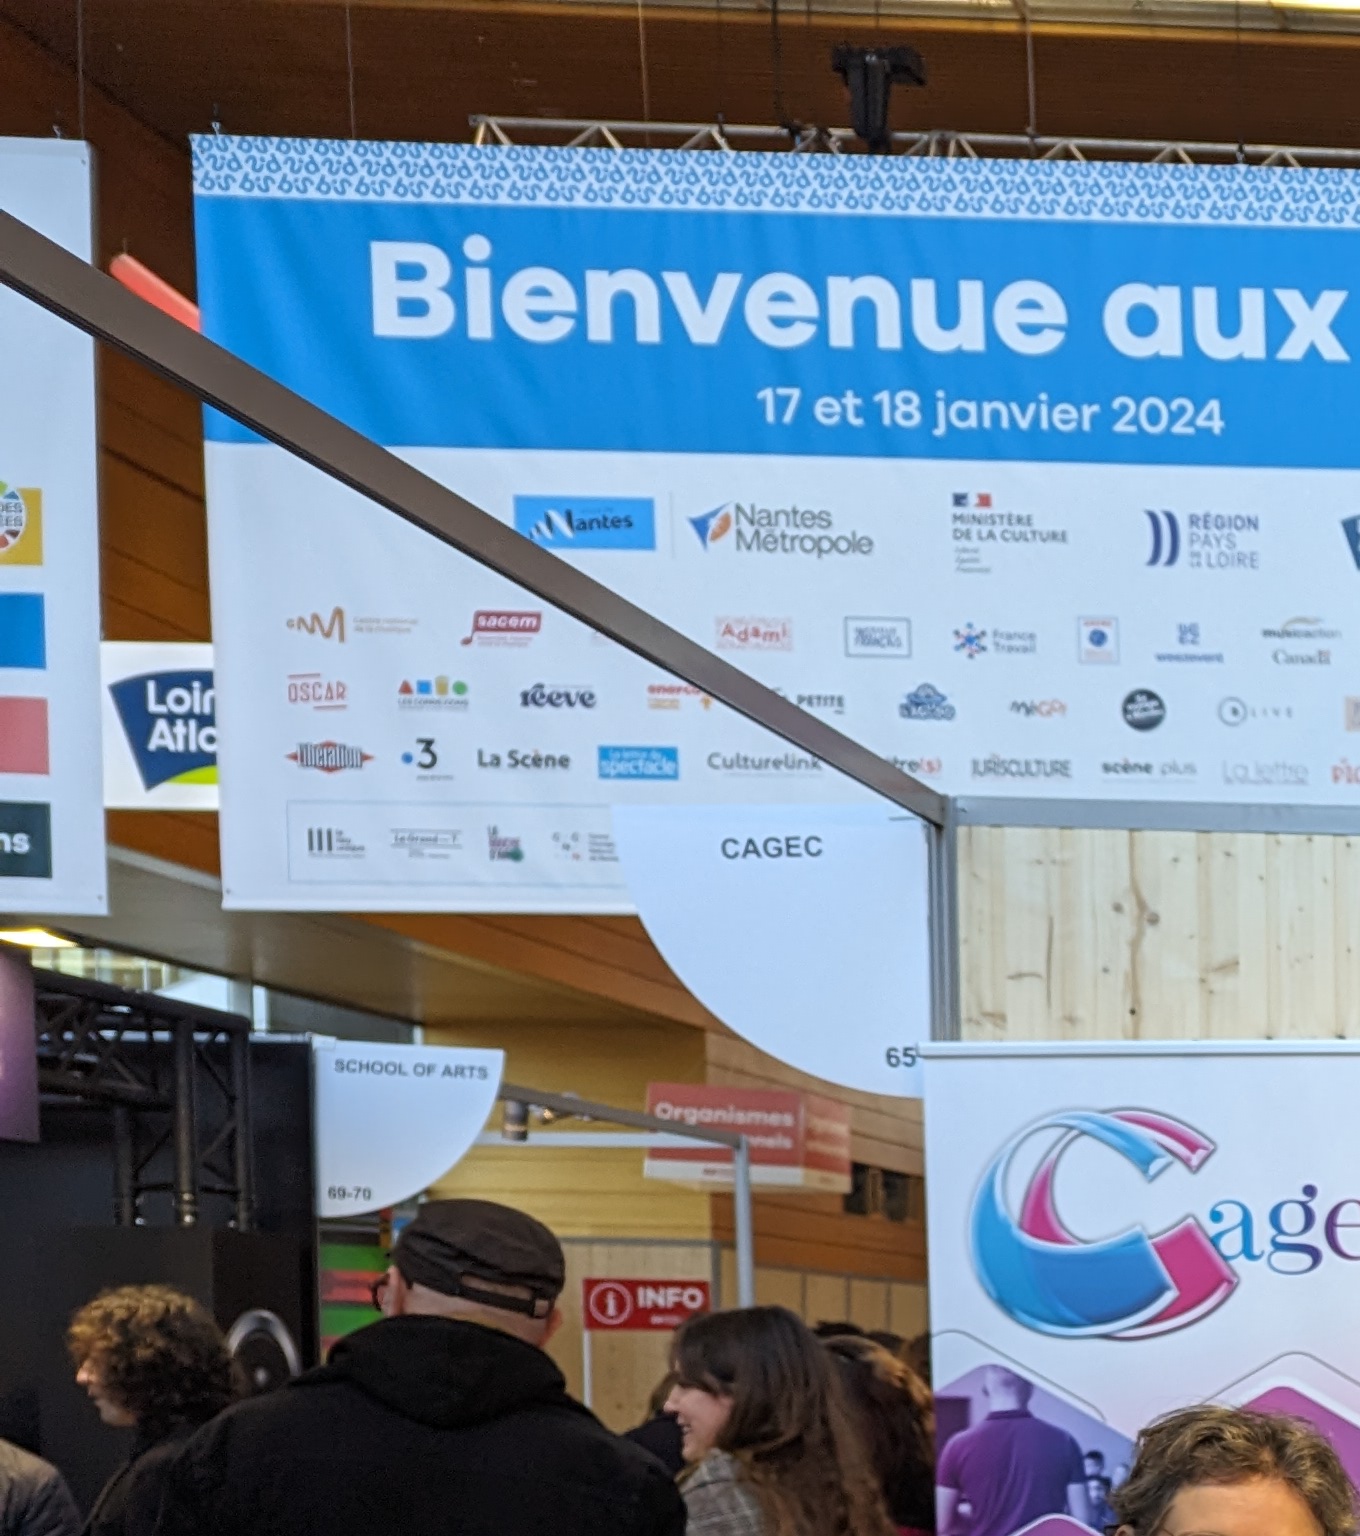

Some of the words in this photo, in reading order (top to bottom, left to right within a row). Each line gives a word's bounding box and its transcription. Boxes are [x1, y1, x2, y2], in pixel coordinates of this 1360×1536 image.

[369, 233, 1069, 356] Bienvenue
[1102, 280, 1352, 364] aux
[756, 387, 800, 425] 17
[813, 391, 864, 428] et
[873, 389, 921, 429] 18
[932, 390, 1100, 437] janvier
[1111, 396, 1225, 436] 2024
[734, 503, 833, 530] Nantes
[952, 511, 1033, 526] MINISTÈRE
[1188, 511, 1259, 532] RÉGION
[735, 529, 874, 558] Métropole
[952, 528, 972, 541] DE
[977, 529, 998, 541] LA
[1000, 529, 1068, 543] CULTURE
[1188, 533, 1237, 550] PAYS
[1204, 552, 1259, 568] LOIRE
[475, 612, 538, 630] sacem
[288, 681, 347, 704] OSCAR
[477, 748, 501, 768] La
[507, 748, 570, 769] Scène
[707, 753, 822, 771] Culturelink
[721, 836, 823, 859] CAGEC
[334, 1058, 407, 1076] SCHOOL
[413, 1062, 437, 1078] OF
[441, 1063, 489, 1081] ARTS
[655, 1102, 795, 1127] Organismes
[327, 1185, 372, 1201] 69-70
[637, 1287, 704, 1309] INFO
